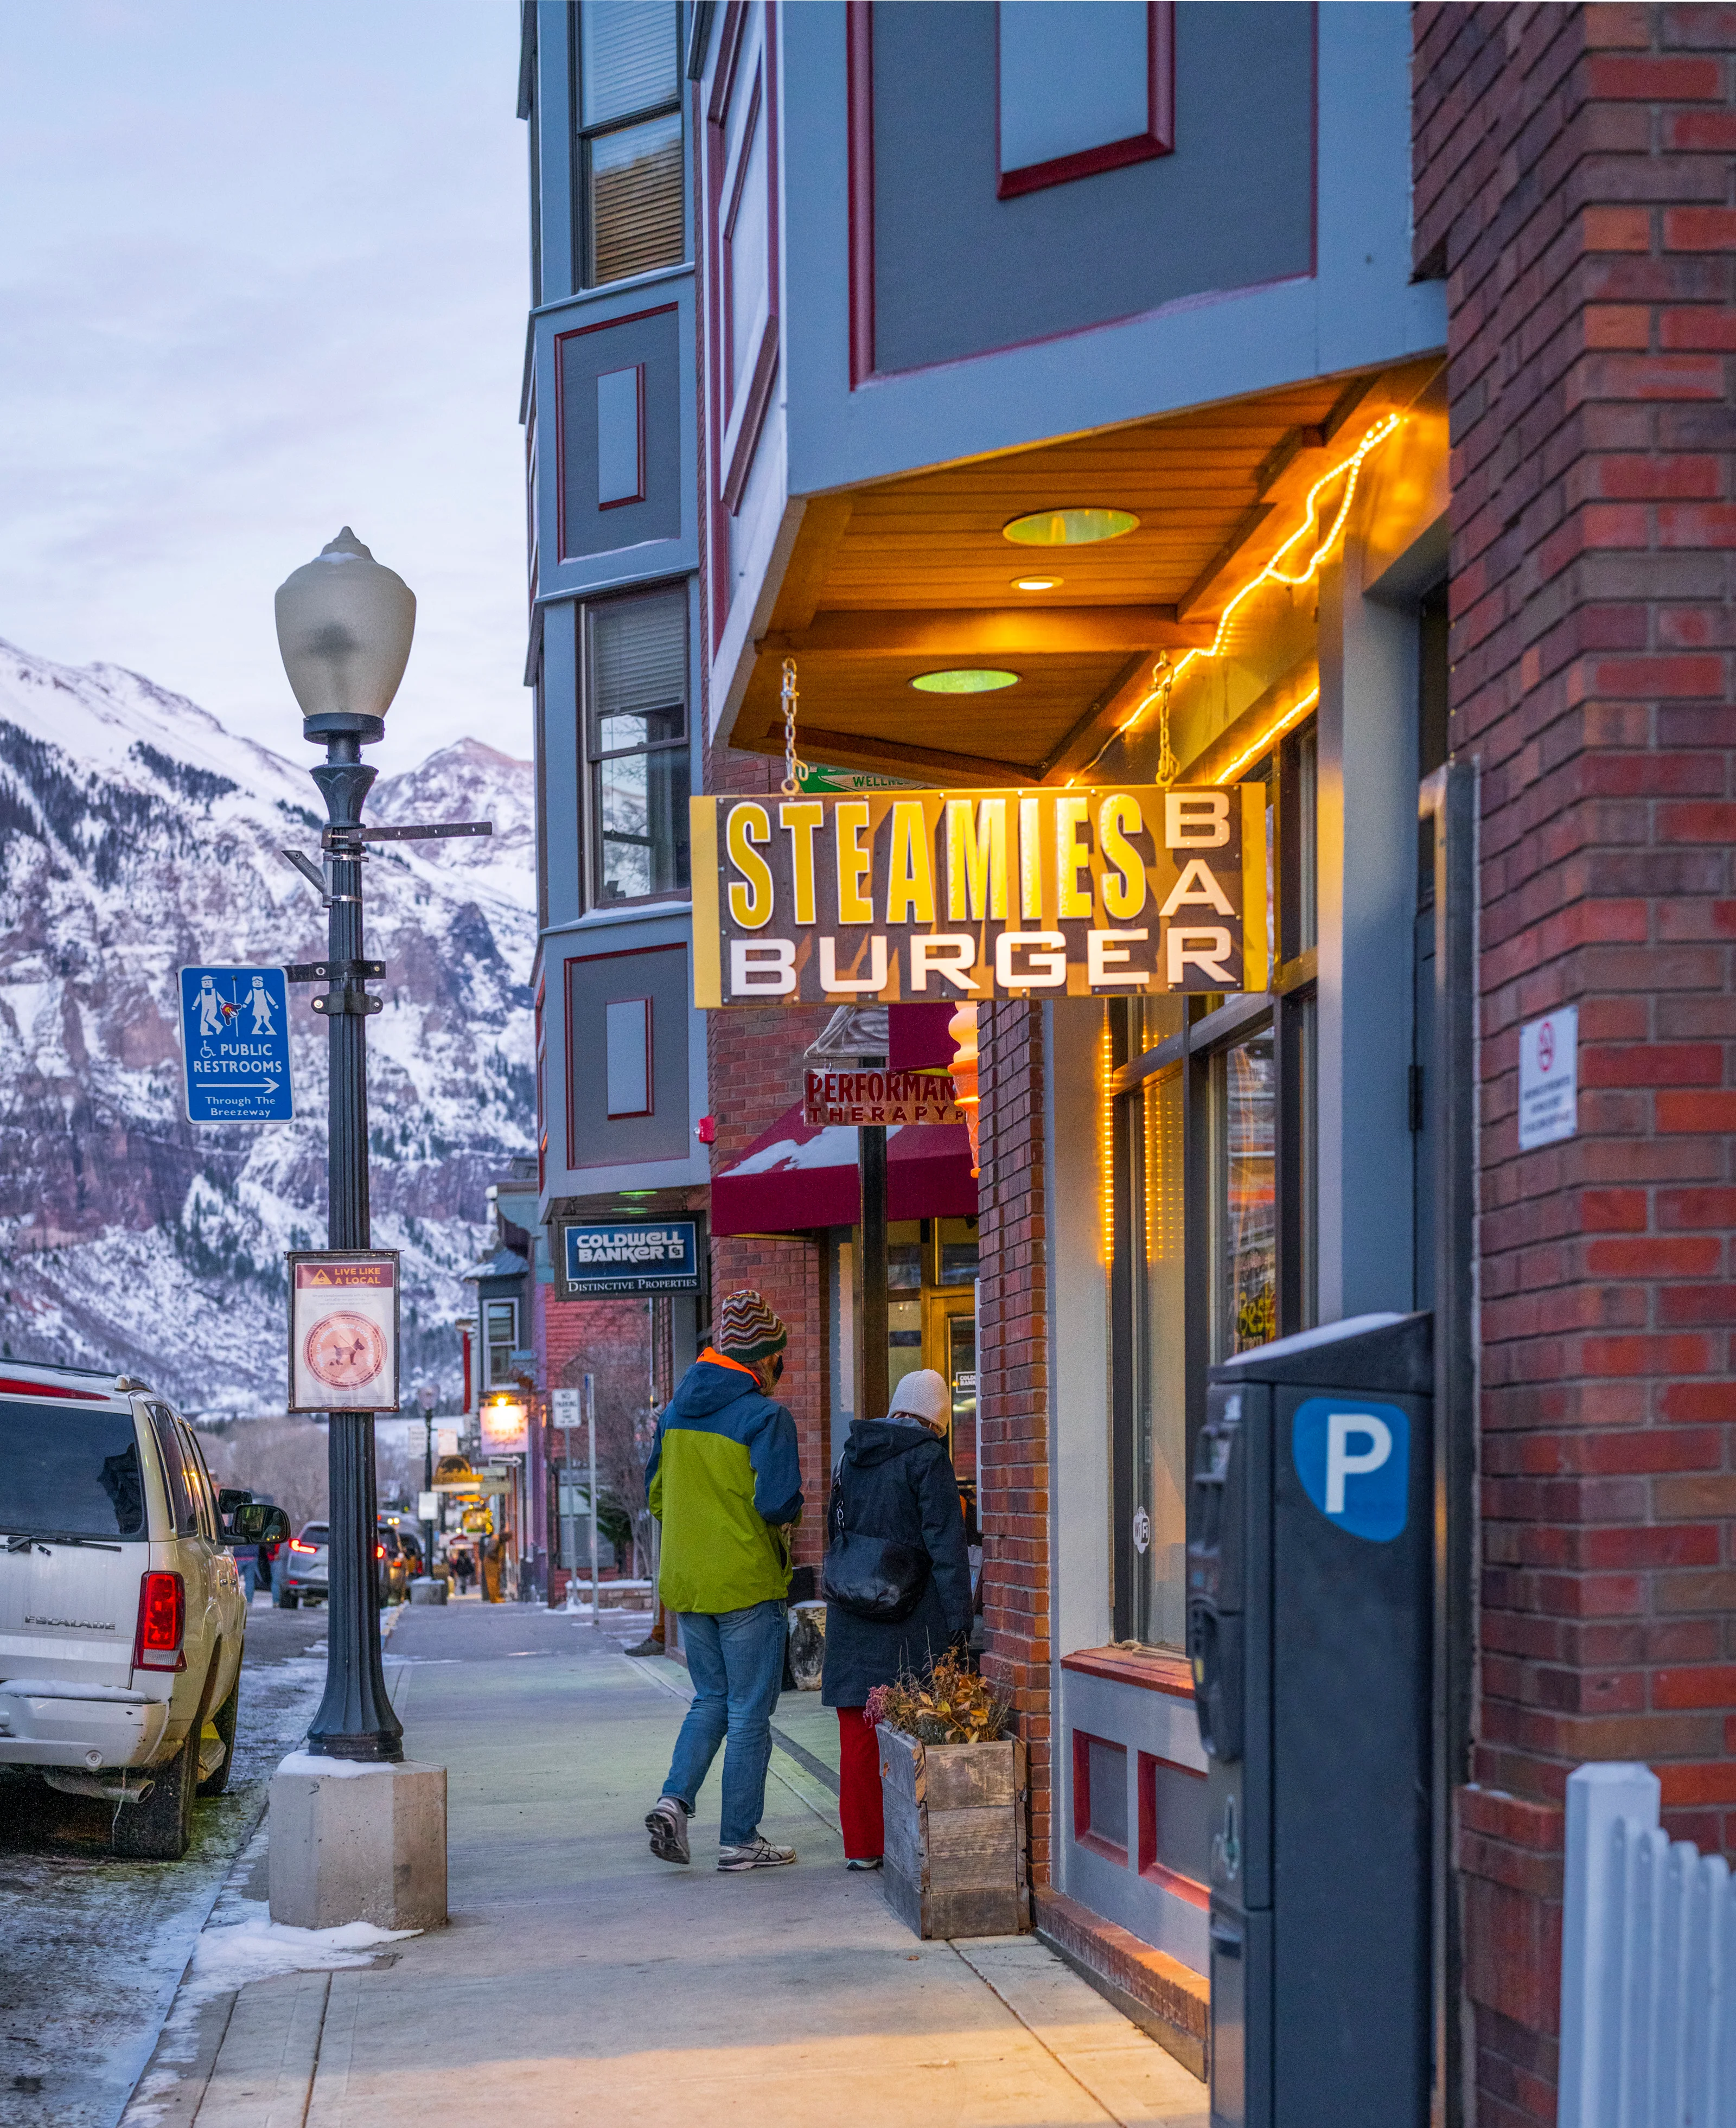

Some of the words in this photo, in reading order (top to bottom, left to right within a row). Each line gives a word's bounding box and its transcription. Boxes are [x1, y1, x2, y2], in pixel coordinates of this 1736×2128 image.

[726, 793, 1146, 930] STEAMIES
[730, 926, 1237, 996] BURGER
[220, 1044, 272, 1056] PUBLIC
[194, 1061, 282, 1073] RESTROOMS
[808, 1072, 956, 1102] PERFORMAN
[205, 1096, 251, 1107] Through
[255, 1096, 276, 1105] The
[210, 1108, 271, 1118] Breezeway
[808, 1105, 948, 1122] THERAPY
[577, 1231, 685, 1248] COLDWELL
[578, 1245, 665, 1263] BANKER
[346, 1276, 381, 1285] LOCAL
[569, 1281, 634, 1292] DISTINCTIVE
[638, 1279, 697, 1289] PROPERTIES
[356, 1326, 369, 1338] DOG
[1325, 1413, 1393, 1514] P
[25, 1616, 116, 1630] ESCALADE
